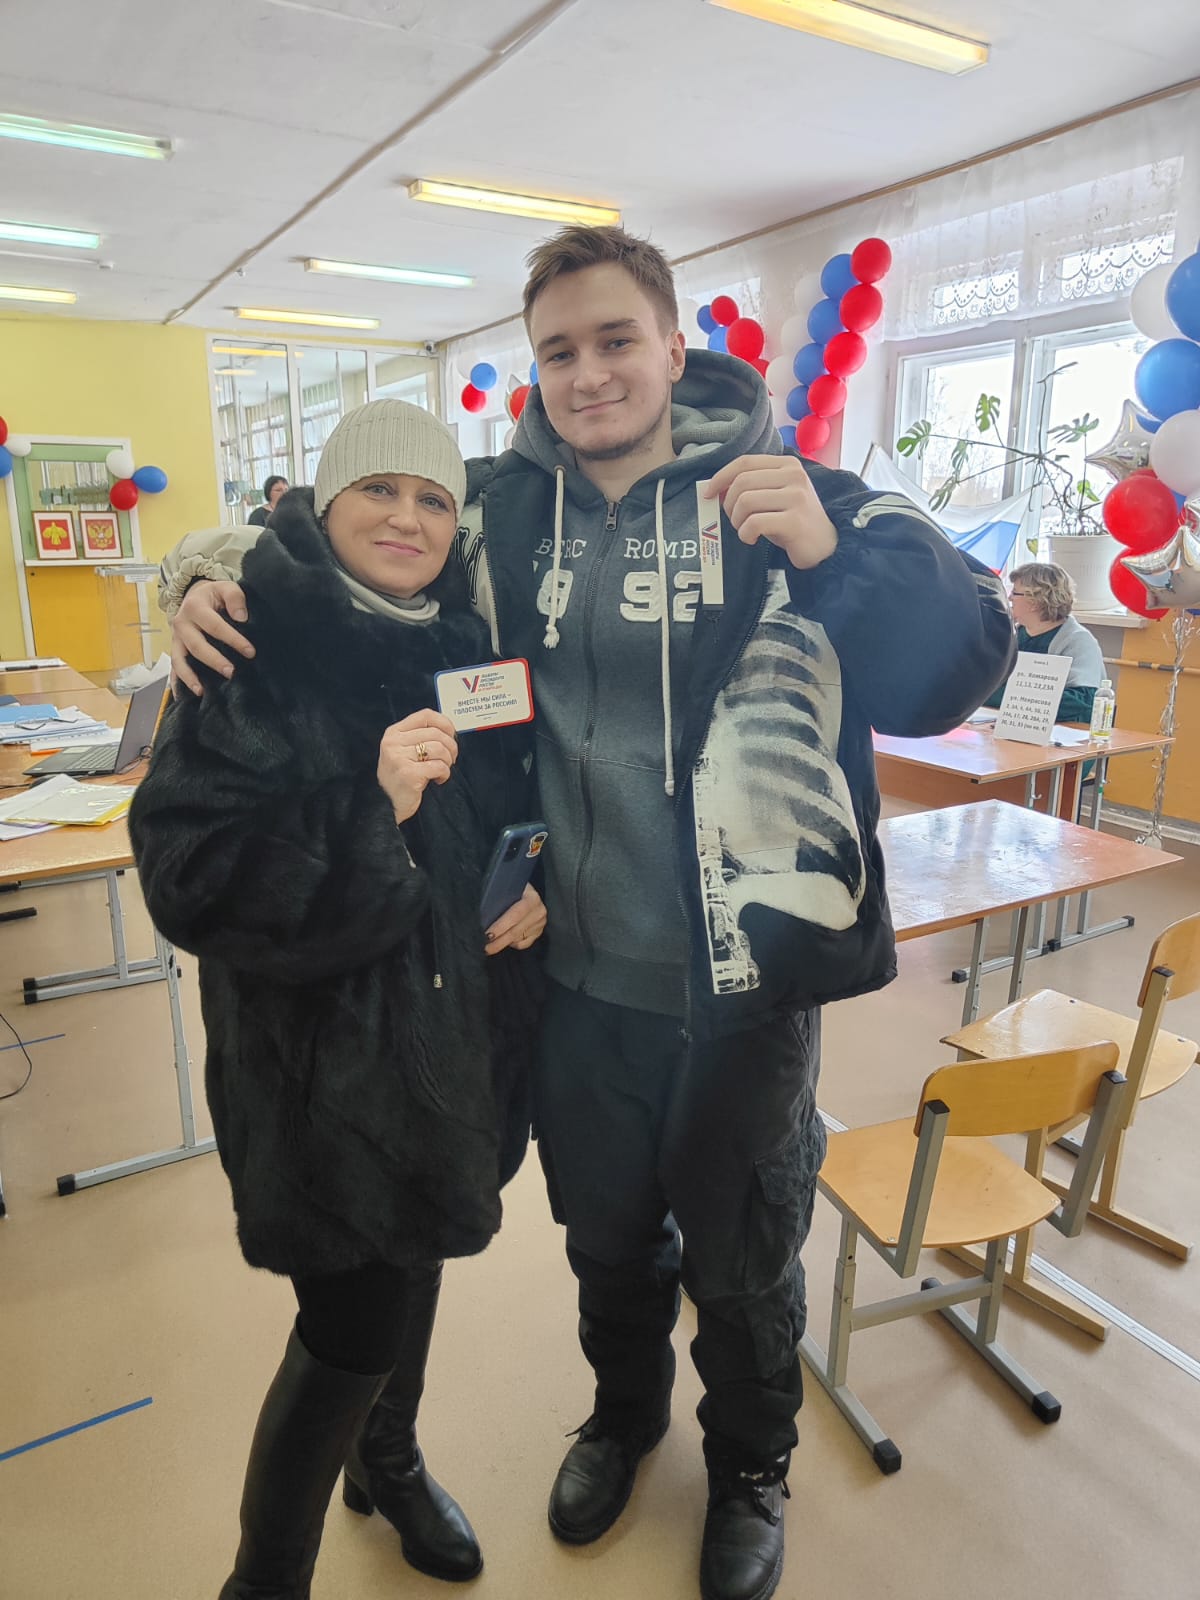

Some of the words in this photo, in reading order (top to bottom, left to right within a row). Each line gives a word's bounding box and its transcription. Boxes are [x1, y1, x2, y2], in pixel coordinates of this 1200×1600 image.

[620, 570, 702, 622] 92
[458, 698, 480, 707] ВМЕСТЕ
[454, 705, 483, 714] ГОЛОСУЕМ
